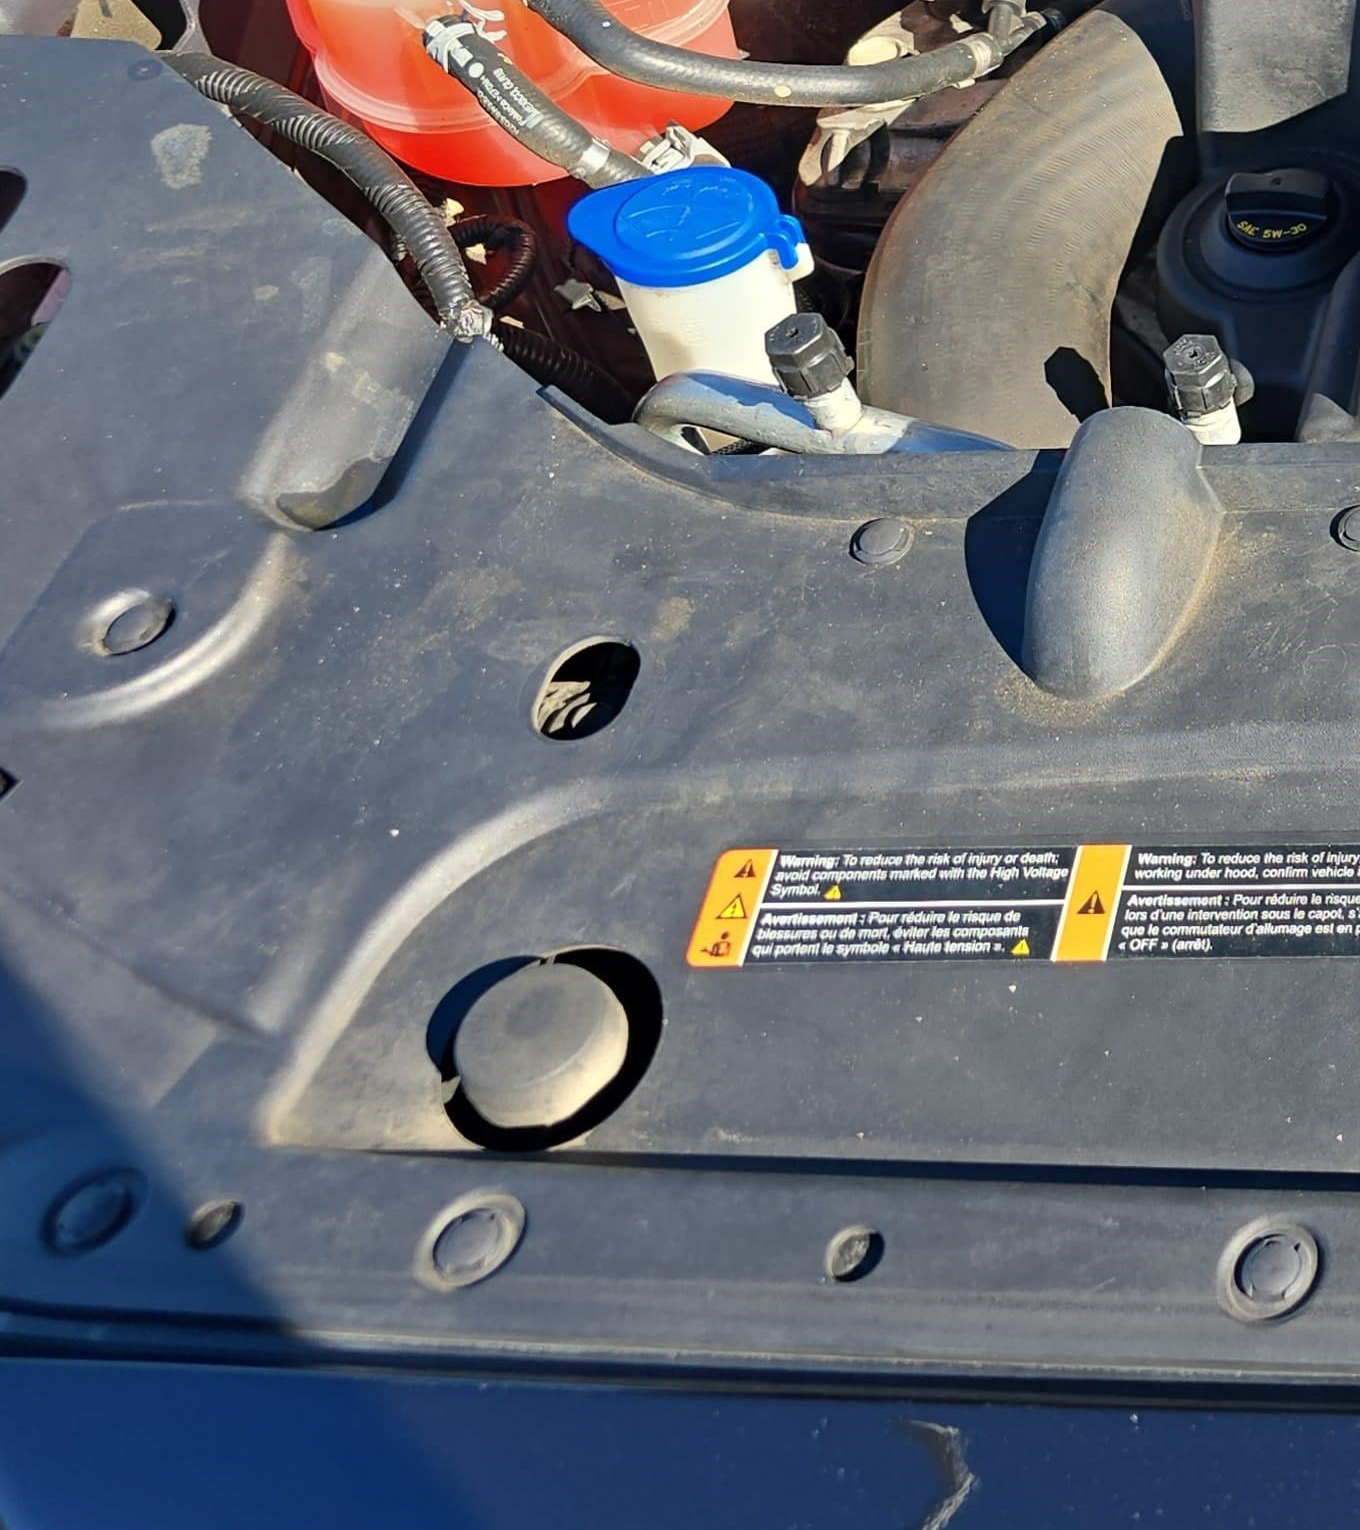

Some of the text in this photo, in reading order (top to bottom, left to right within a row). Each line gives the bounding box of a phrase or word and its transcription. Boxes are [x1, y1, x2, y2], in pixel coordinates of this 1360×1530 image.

[1237, 221, 1308, 239] SAE 5W-30
[780, 853, 1018, 869] Warning: To reduce the risk of injury or
[1138, 853, 1197, 866] Warning:
[1201, 853, 1215, 864] To
[1218, 853, 1260, 864] reduce
[1264, 852, 1283, 863] the
[1287, 852, 1309, 862] risk
[1312, 852, 1326, 862] of
[775, 867, 1068, 884] avoid components marked with the High Voltage
[1135, 867, 1182, 881] working
[1185, 867, 1221, 879] under
[1224, 867, 1259, 879] hood,
[1262, 866, 1308, 877] confirm
[1312, 866, 1354, 877] vehicle
[770, 885, 821, 898] Symbol.
[1127, 894, 1222, 906] Avertissement
[1233, 894, 1262, 905] Pour
[1265, 893, 1308, 905] réduire
[1311, 894, 1321, 904] le
[761, 910, 1020, 925] Avertissement Pour réduire le risque de
[1125, 910, 1147, 920] lors
[1151, 910, 1184, 920] d'une
[1188, 909, 1258, 920] intervention
[1261, 909, 1290, 919] sous
[1293, 908, 1305, 919] le
[1308, 908, 1344, 920] capot,
[757, 926, 1029, 940] blessures ou de mort, éviter les composants
[1121, 926, 1144, 937] que
[1147, 925, 1159, 935] le
[1162, 924, 1243, 935] commutateur
[1245, 924, 1312, 936] d'allumage
[1315, 923, 1334, 934] est
[1337, 925, 1352, 933] en
[752, 941, 990, 958] qui portent le symbole Haute tension
[1130, 939, 1158, 951] OFF
